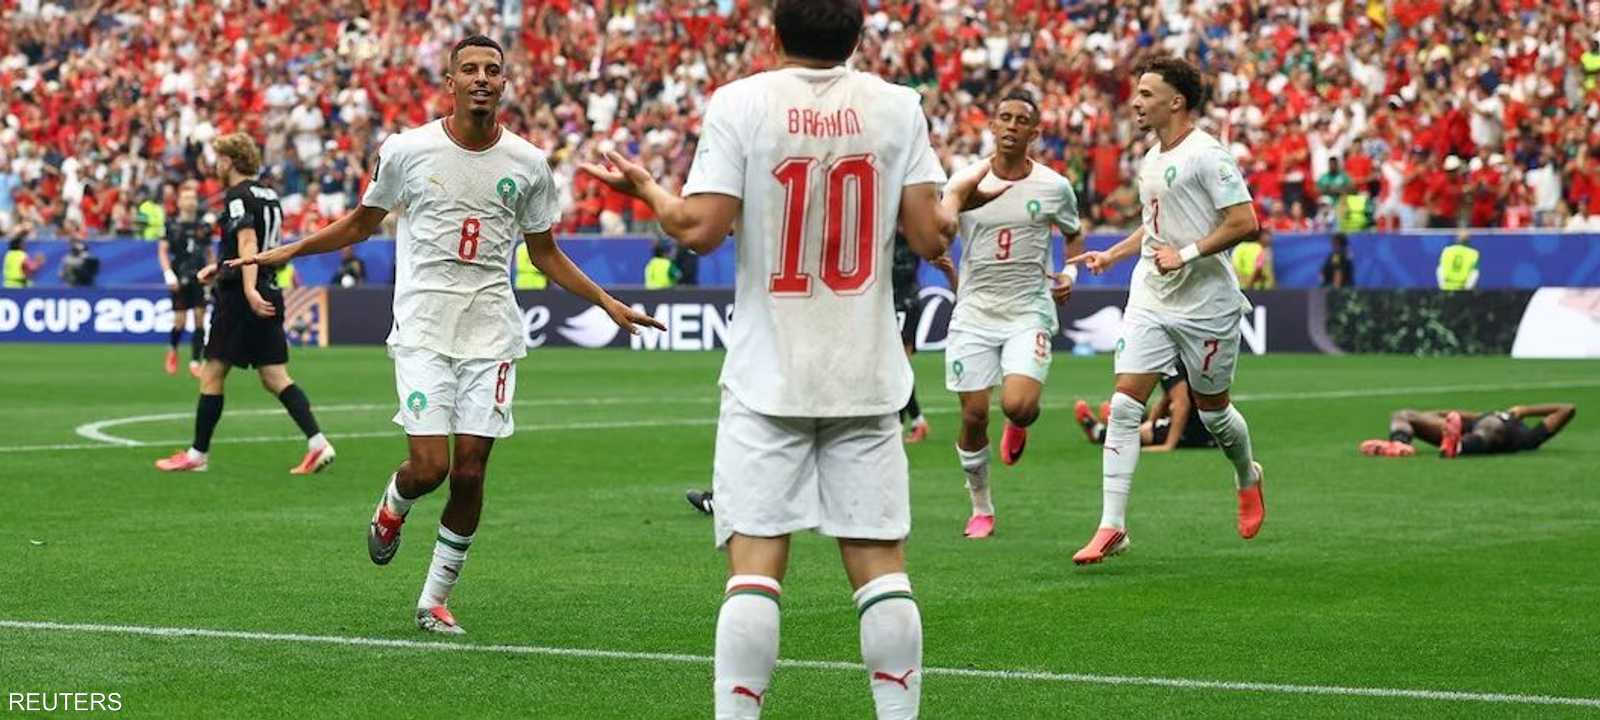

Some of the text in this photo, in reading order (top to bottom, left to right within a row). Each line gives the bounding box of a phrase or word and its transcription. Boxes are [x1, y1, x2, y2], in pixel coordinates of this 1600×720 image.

[458, 216, 481, 261] 8
[769, 154, 879, 296] 10
[995, 227, 1012, 261] 9
[23, 298, 92, 333] CUP
[1034, 330, 1048, 358] 9
[1203, 338, 1218, 372] 7
[495, 361, 511, 405] 8
